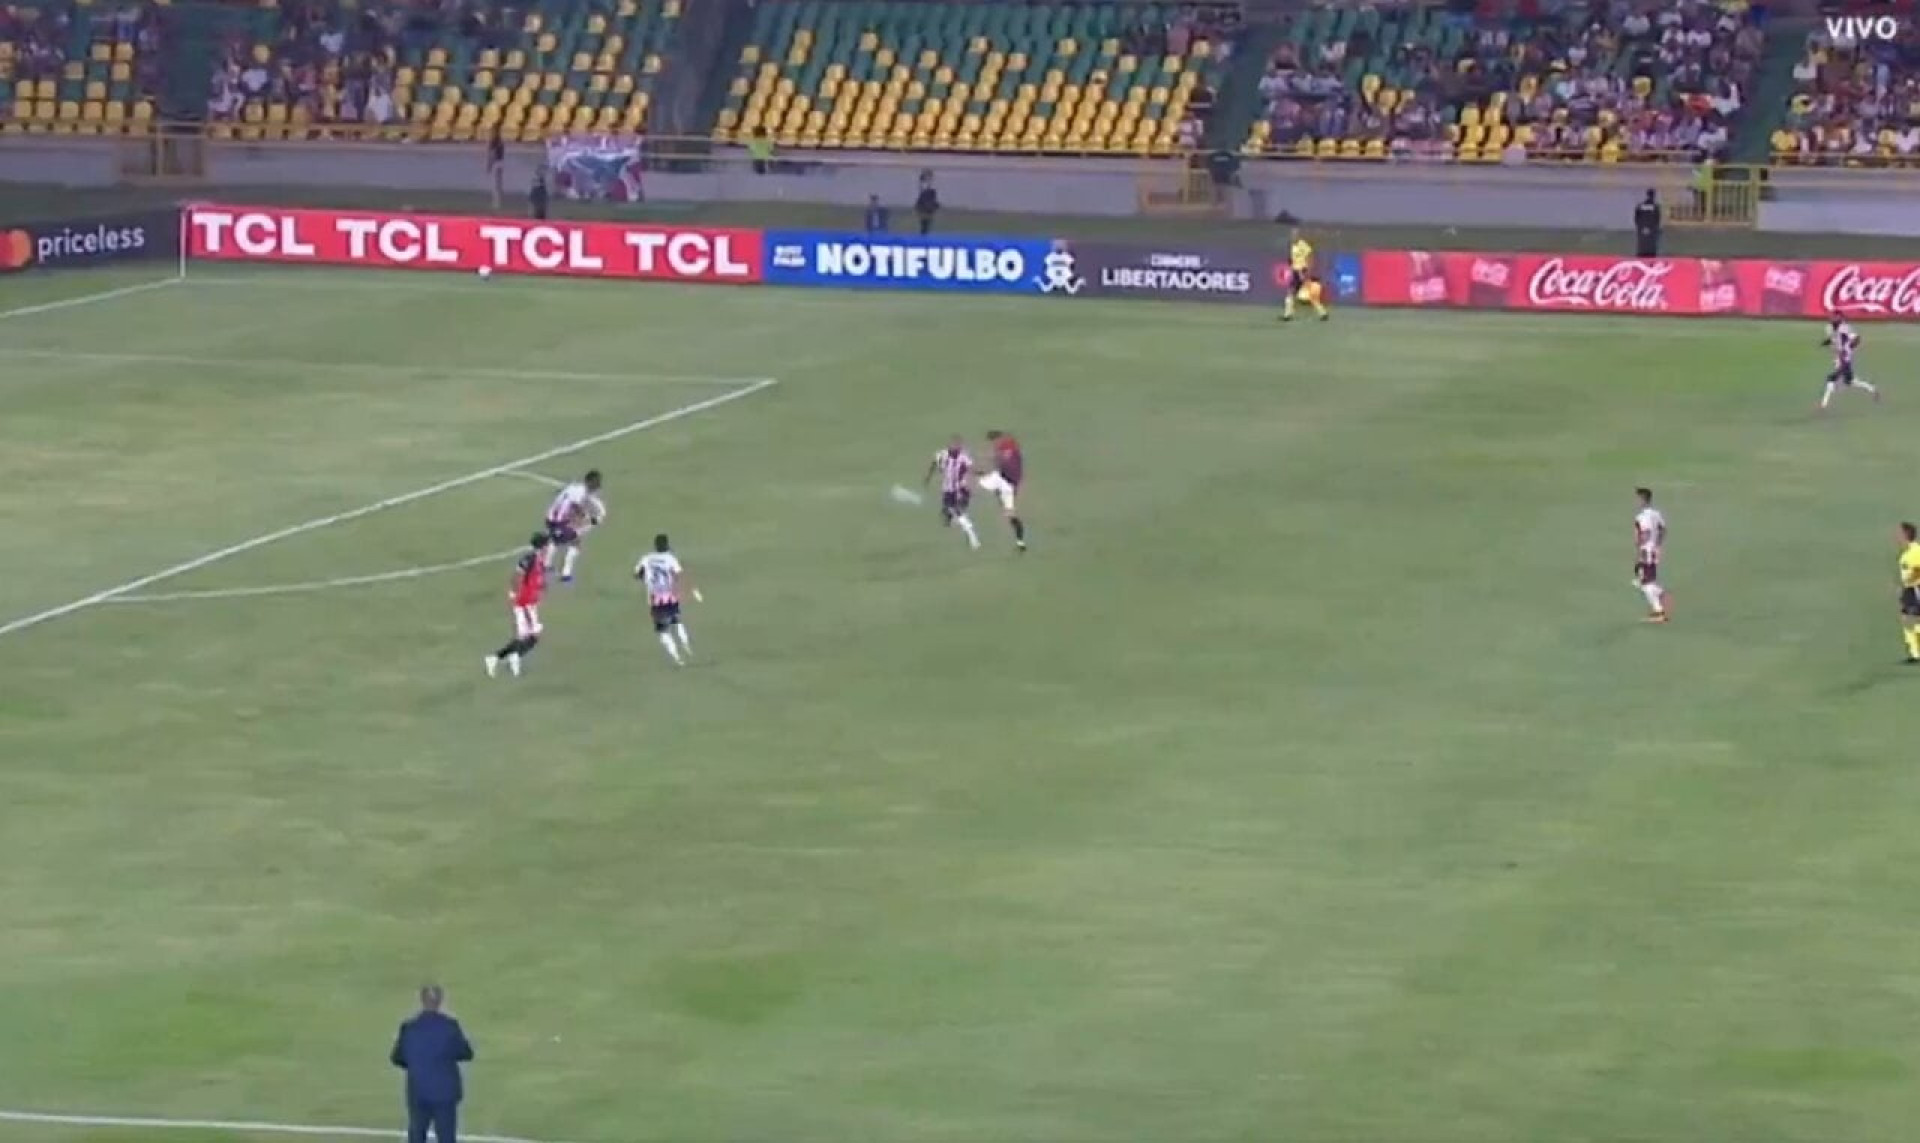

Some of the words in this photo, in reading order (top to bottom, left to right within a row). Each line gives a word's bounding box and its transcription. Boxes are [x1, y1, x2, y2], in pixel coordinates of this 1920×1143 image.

[38, 224, 145, 261] priceless
[193, 213, 314, 256] TCL
[336, 219, 458, 262] TCL
[480, 226, 602, 269] TCL
[624, 231, 748, 275] TCL
[816, 242, 1024, 281] NOTIFULBO
[1101, 268, 1250, 291] LIBERTADORES
[1530, 258, 1671, 308] Coca-Cola
